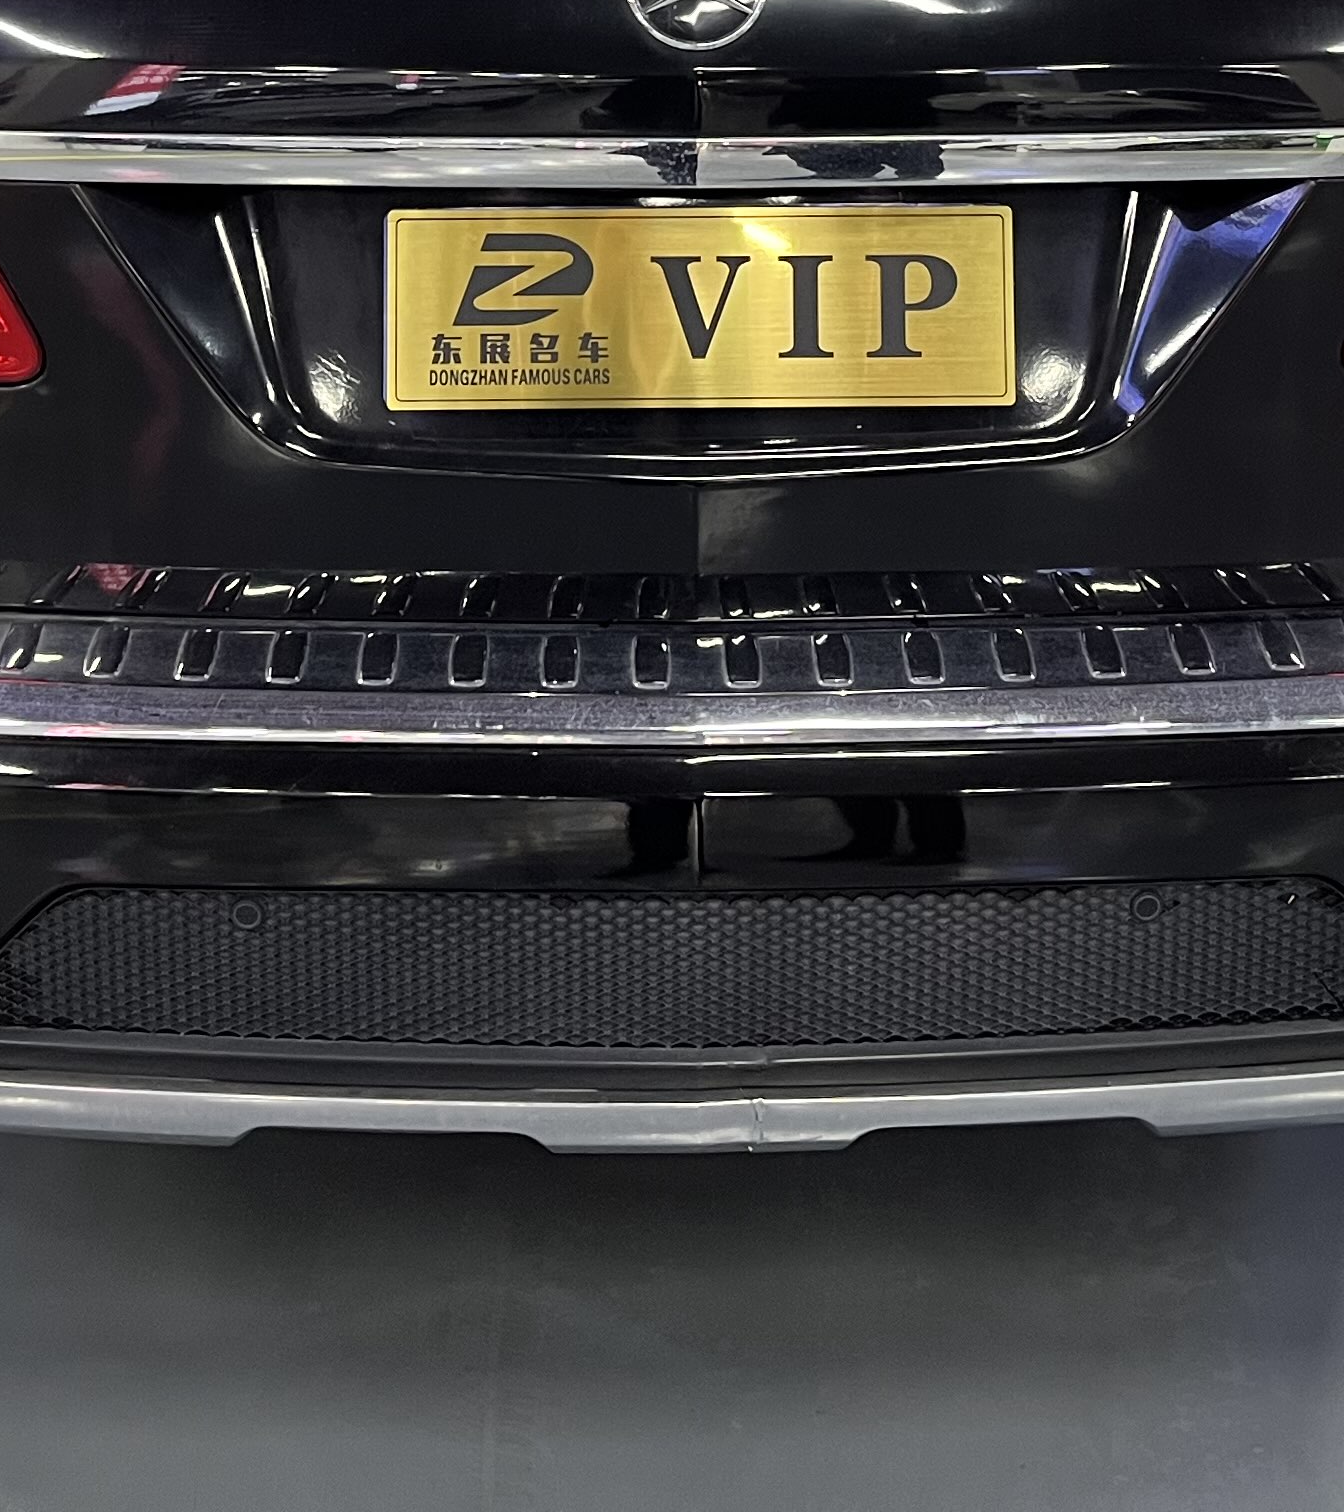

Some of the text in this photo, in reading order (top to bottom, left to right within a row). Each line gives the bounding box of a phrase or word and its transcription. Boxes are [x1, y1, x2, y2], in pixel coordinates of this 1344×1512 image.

[650, 254, 958, 359] VIP
[430, 332, 610, 365] 东展名车
[429, 368, 611, 386] DONGZHAN FAMOUS CARS
